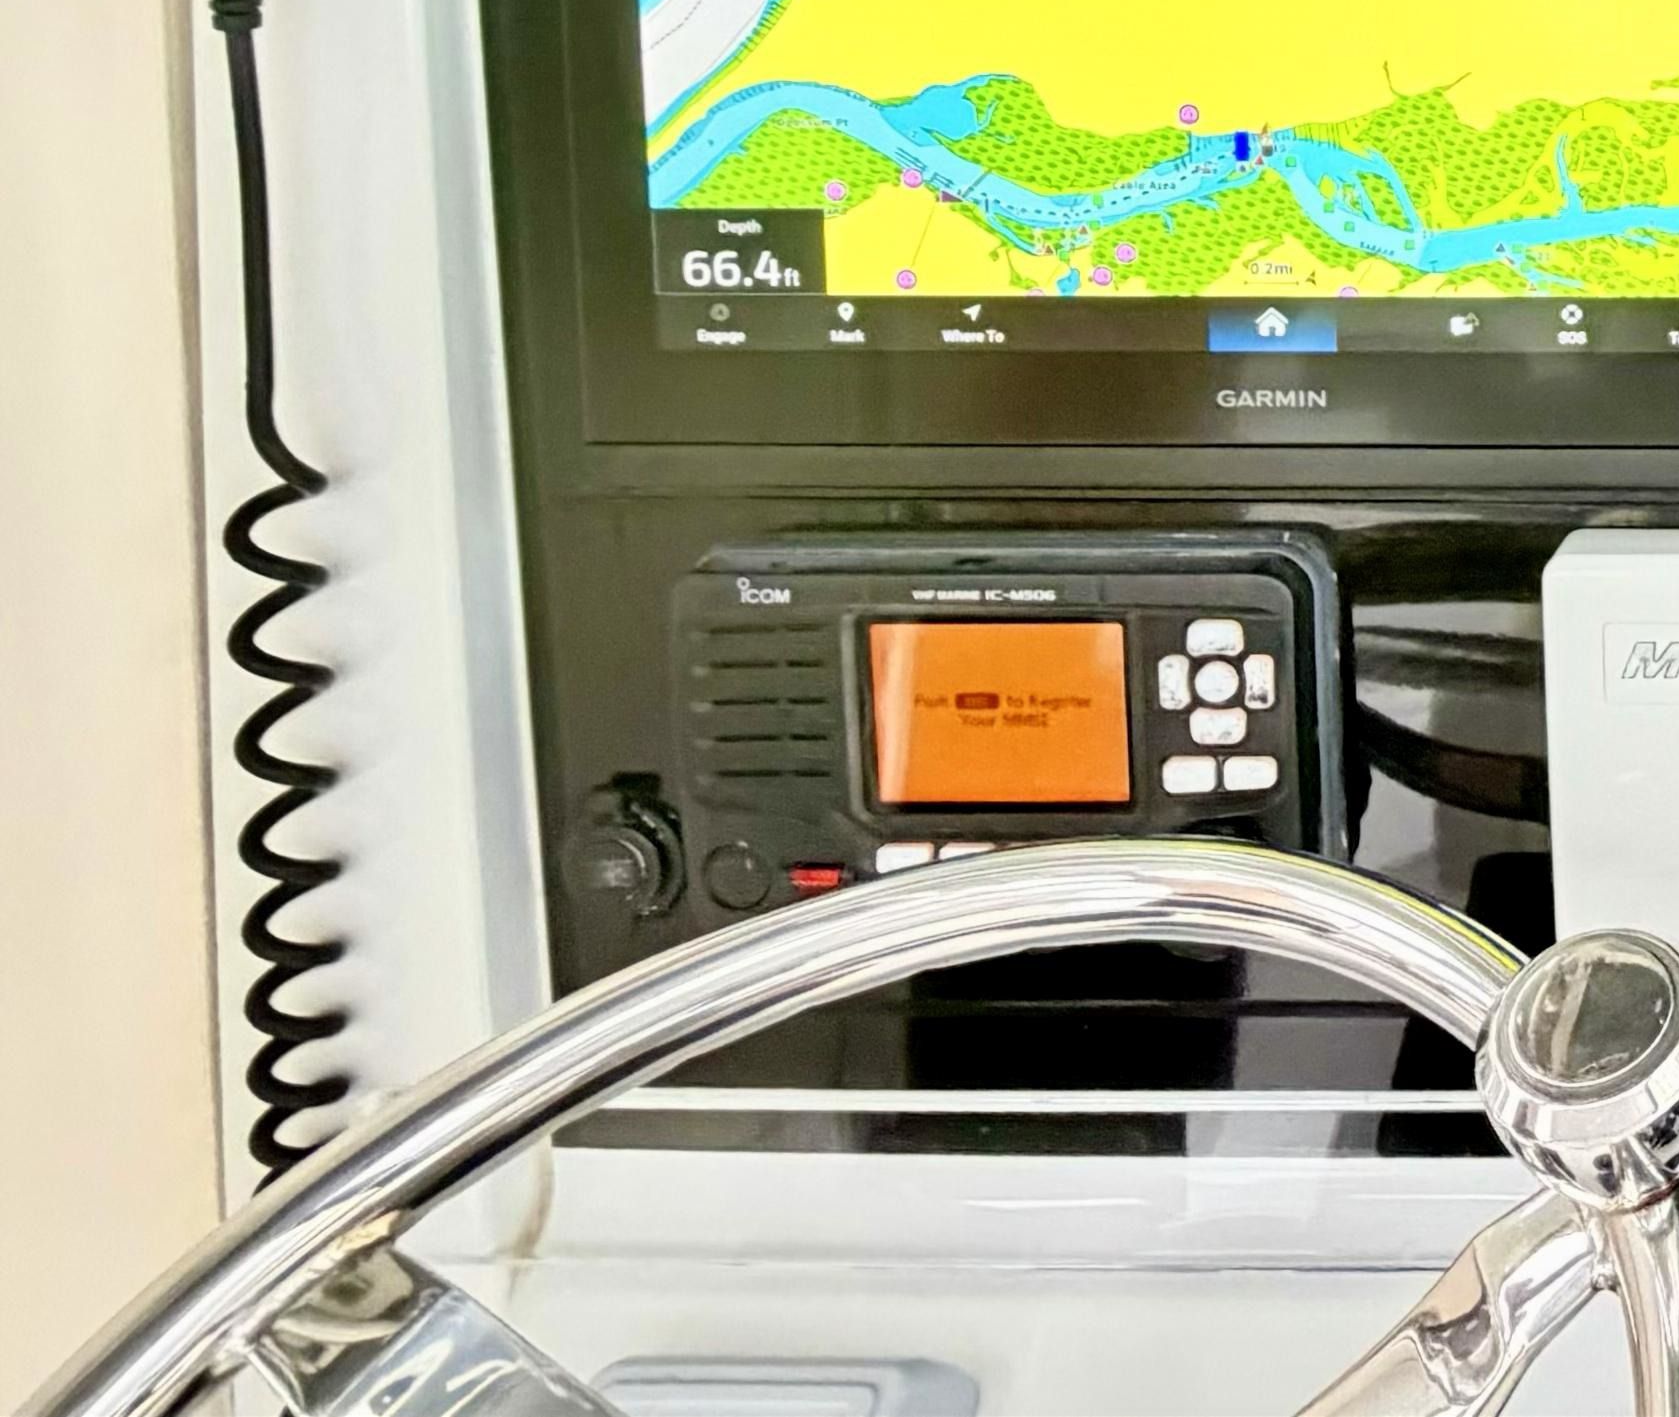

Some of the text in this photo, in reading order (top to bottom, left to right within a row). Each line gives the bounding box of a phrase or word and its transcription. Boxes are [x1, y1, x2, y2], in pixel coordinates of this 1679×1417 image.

[717, 219, 763, 236] Depth
[696, 328, 747, 346] Engage
[829, 328, 866, 344] Mark
[940, 328, 1005, 344] Where To
[1556, 330, 1588, 346] SOS
[1215, 389, 1328, 409] GARMIN
